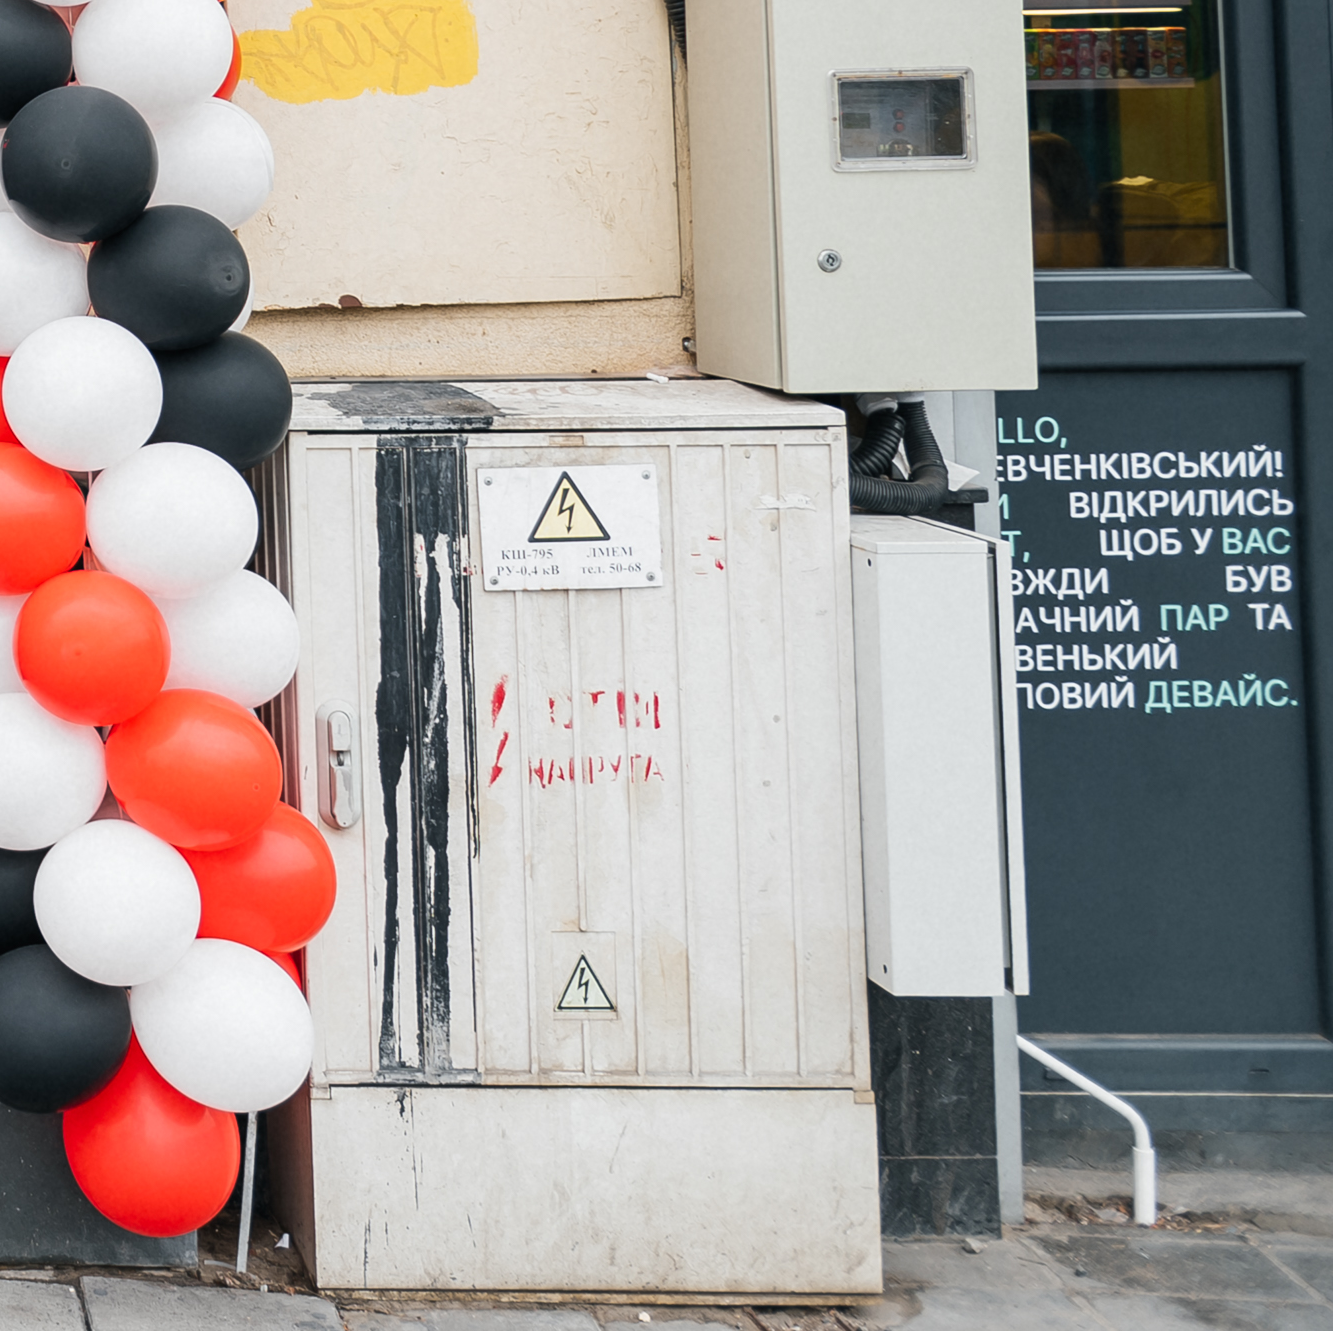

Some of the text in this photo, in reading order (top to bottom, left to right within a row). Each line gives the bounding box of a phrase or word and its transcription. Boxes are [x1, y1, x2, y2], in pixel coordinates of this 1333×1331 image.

[997, 416, 1067, 449] LLO,
[1069, 489, 1294, 523] ВІДКРИЛИСЬ
[501, 546, 634, 560] КШ-795 ЛМЕМ
[1099, 527, 1182, 561] ЩОБ
[1190, 527, 1213, 555] У
[1222, 526, 1291, 555] ВАС
[542, 564, 560, 575] кВ
[579, 565, 605, 574] тел.
[609, 561, 642, 573] 50-68
[1225, 564, 1293, 593] БУВ
[1015, 598, 1293, 633] АЧНИЙ ПАР ТА
[1015, 636, 1178, 672] ВЕНЬКИЙ
[1144, 673, 1299, 714] ДЕВАЙС.
